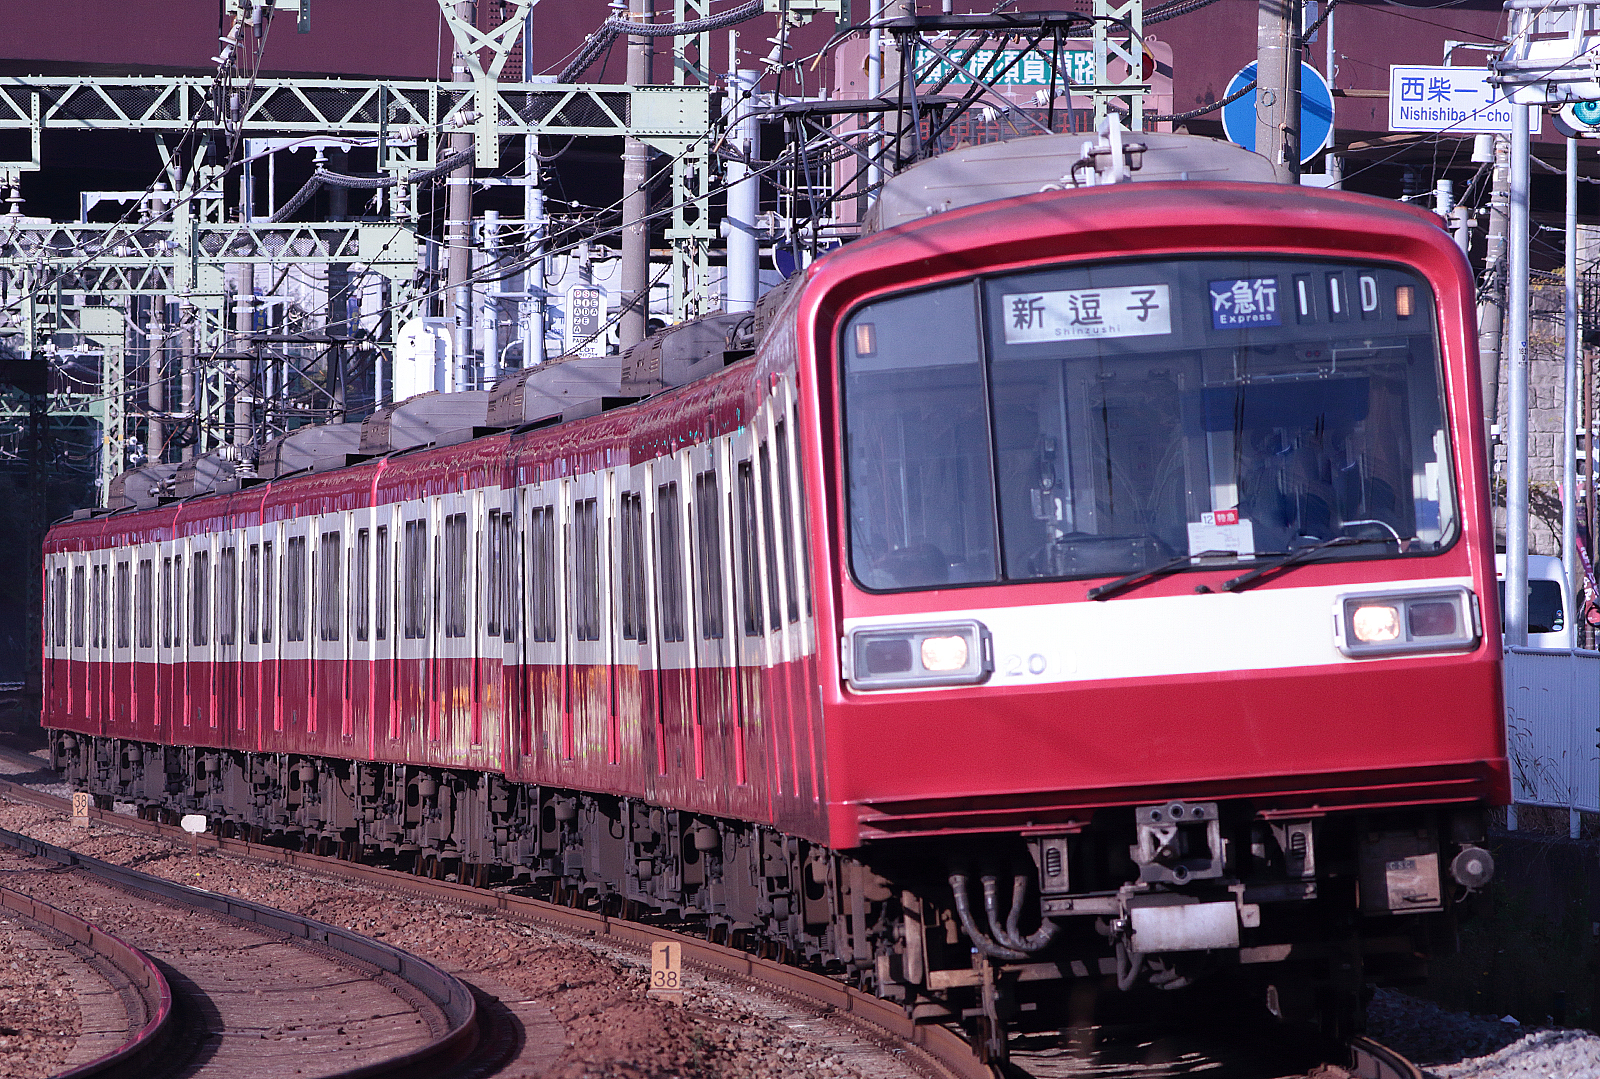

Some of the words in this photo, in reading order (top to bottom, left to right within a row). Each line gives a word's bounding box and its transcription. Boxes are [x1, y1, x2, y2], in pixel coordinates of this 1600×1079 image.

[1400, 76, 1513, 104] 西柴一丁
[1400, 106, 1466, 122] Nishishiba
[1471, 108, 1513, 122] 1-cho
[1231, 278, 1277, 314] 急行
[1012, 290, 1160, 330] 新逗子
[1219, 313, 1273, 325] Express
[1054, 323, 1121, 337] Shinzushi
[1203, 515, 1214, 525] 12
[76, 807, 85, 816] K
[659, 945, 670, 970] 1
[654, 970, 678, 988] 38
